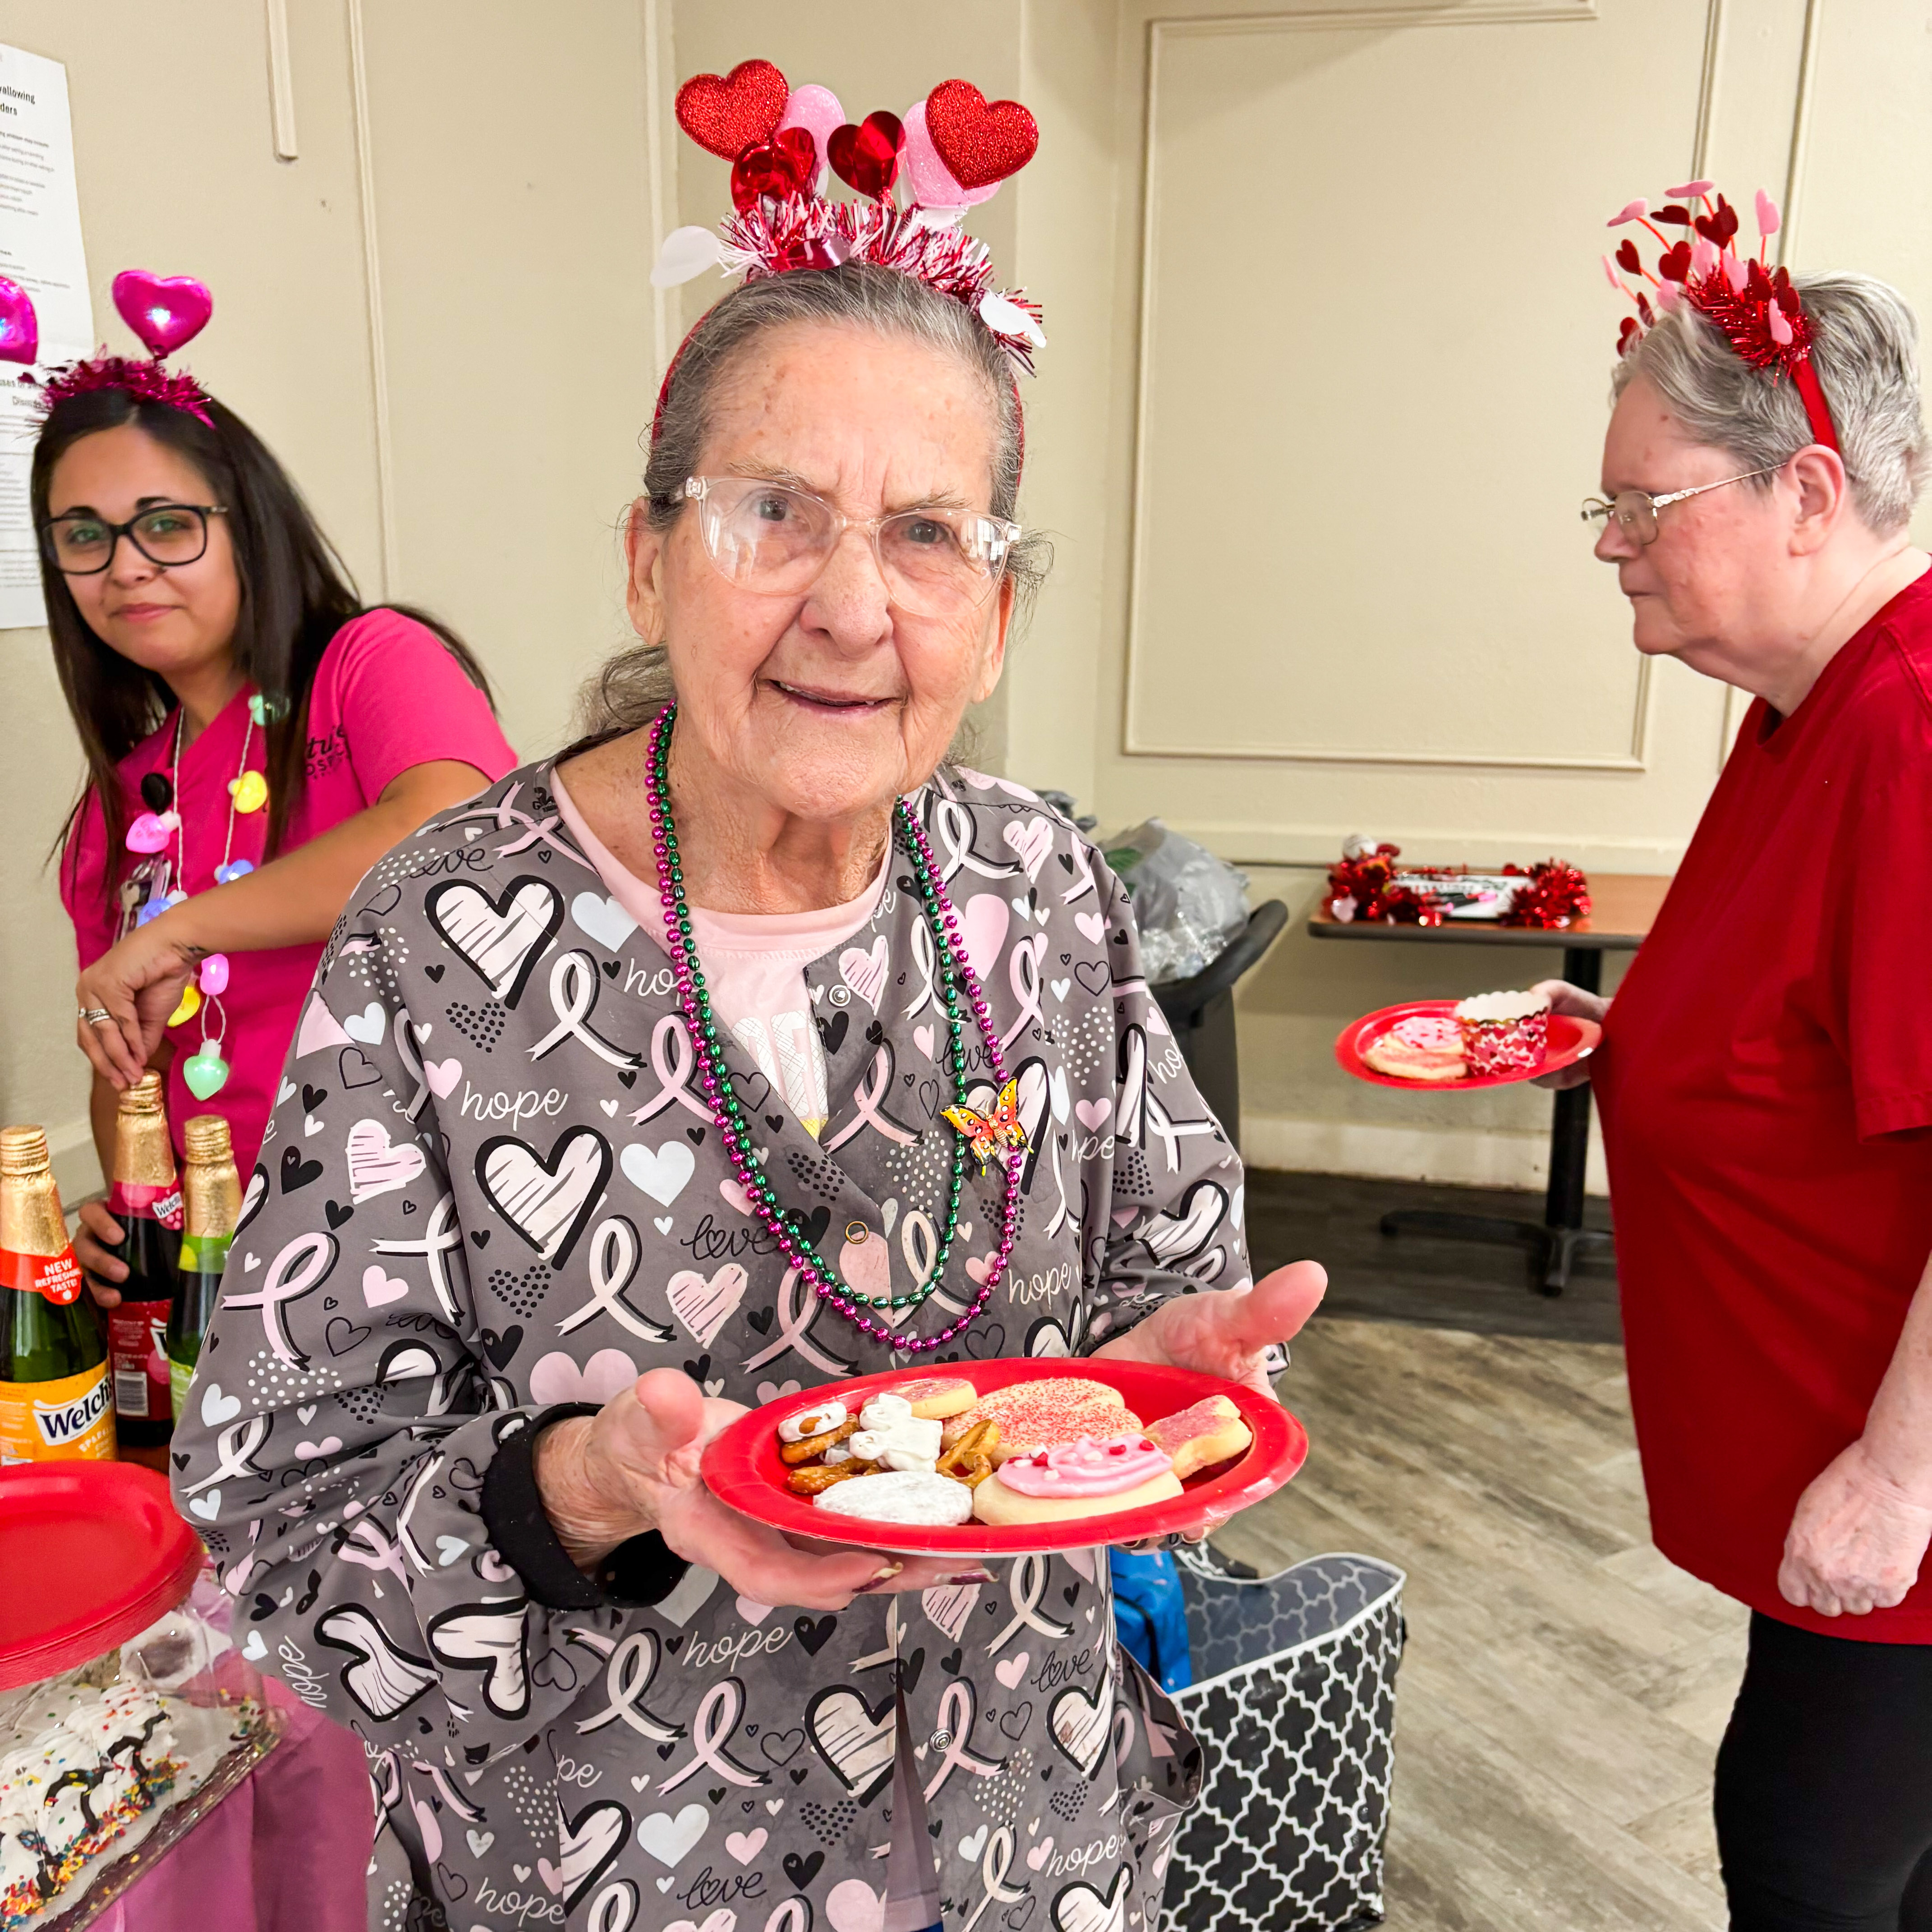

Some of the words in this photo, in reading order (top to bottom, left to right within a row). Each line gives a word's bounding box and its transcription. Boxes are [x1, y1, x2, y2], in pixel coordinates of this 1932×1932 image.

[0, 85, 35, 105] allowing
[461, 1081, 568, 1131] hope
[44, 1258, 72, 1276] NEW
[1008, 1262, 1071, 1310] hope
[682, 1627, 793, 1672] hope
[1030, 1648, 1093, 1693] love
[1046, 1835, 1120, 1877] hope
[475, 1877, 565, 1927] hope
[676, 1866, 768, 1910] love
